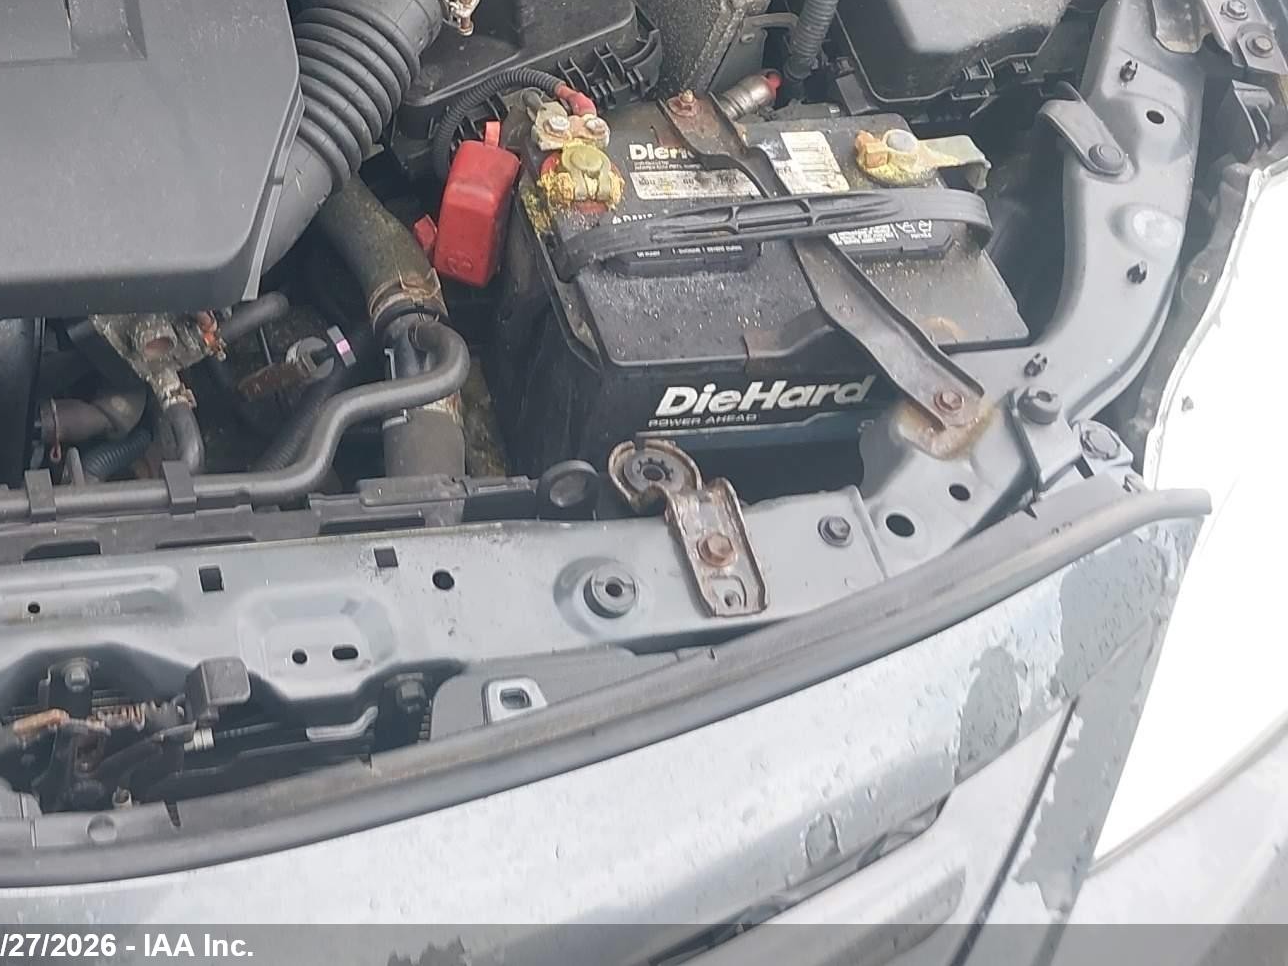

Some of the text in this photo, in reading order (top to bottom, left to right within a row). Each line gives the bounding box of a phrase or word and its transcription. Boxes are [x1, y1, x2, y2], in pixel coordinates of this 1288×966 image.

[654, 375, 876, 417] DieHard
[648, 412, 758, 428] POWER AHEAD
